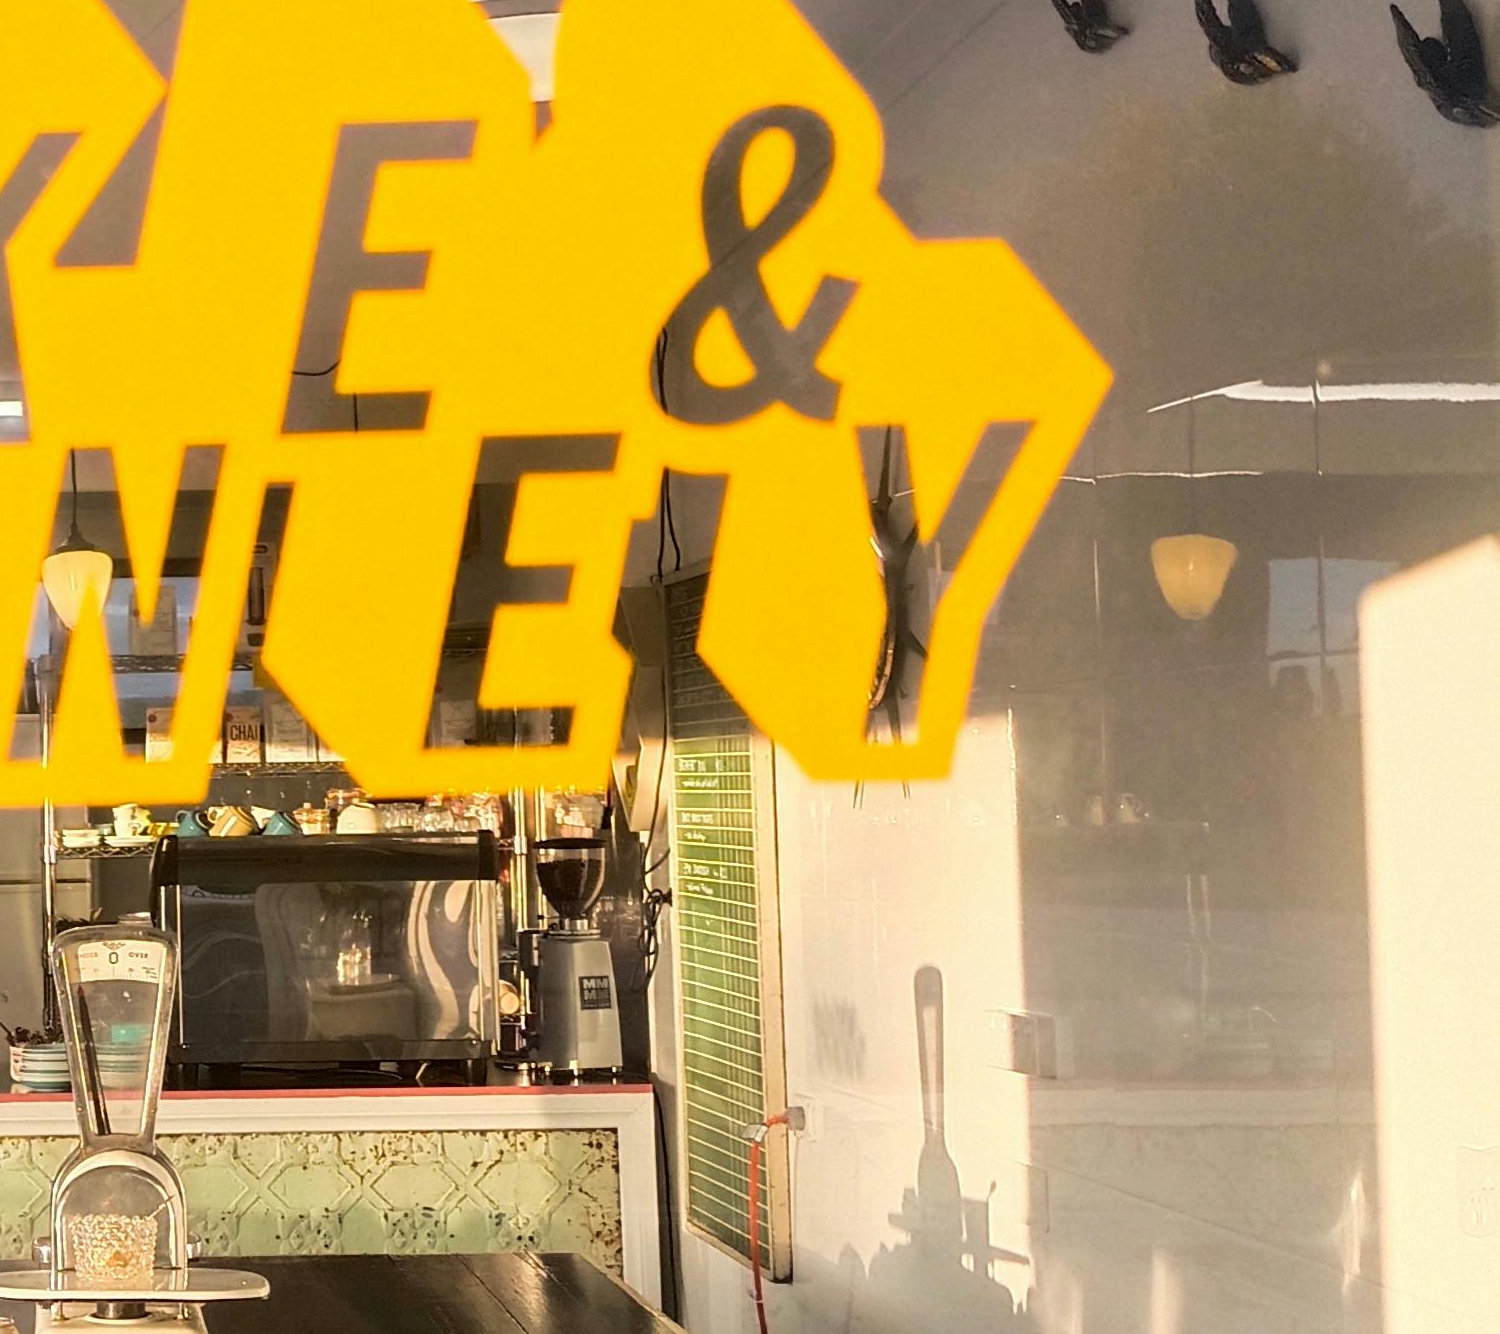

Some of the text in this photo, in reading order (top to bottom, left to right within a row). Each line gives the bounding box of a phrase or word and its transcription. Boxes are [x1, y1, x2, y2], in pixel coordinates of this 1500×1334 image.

[648, 103, 862, 428] &
[229, 724, 258, 742] CHAI
[128, 951, 148, 959] OVER
